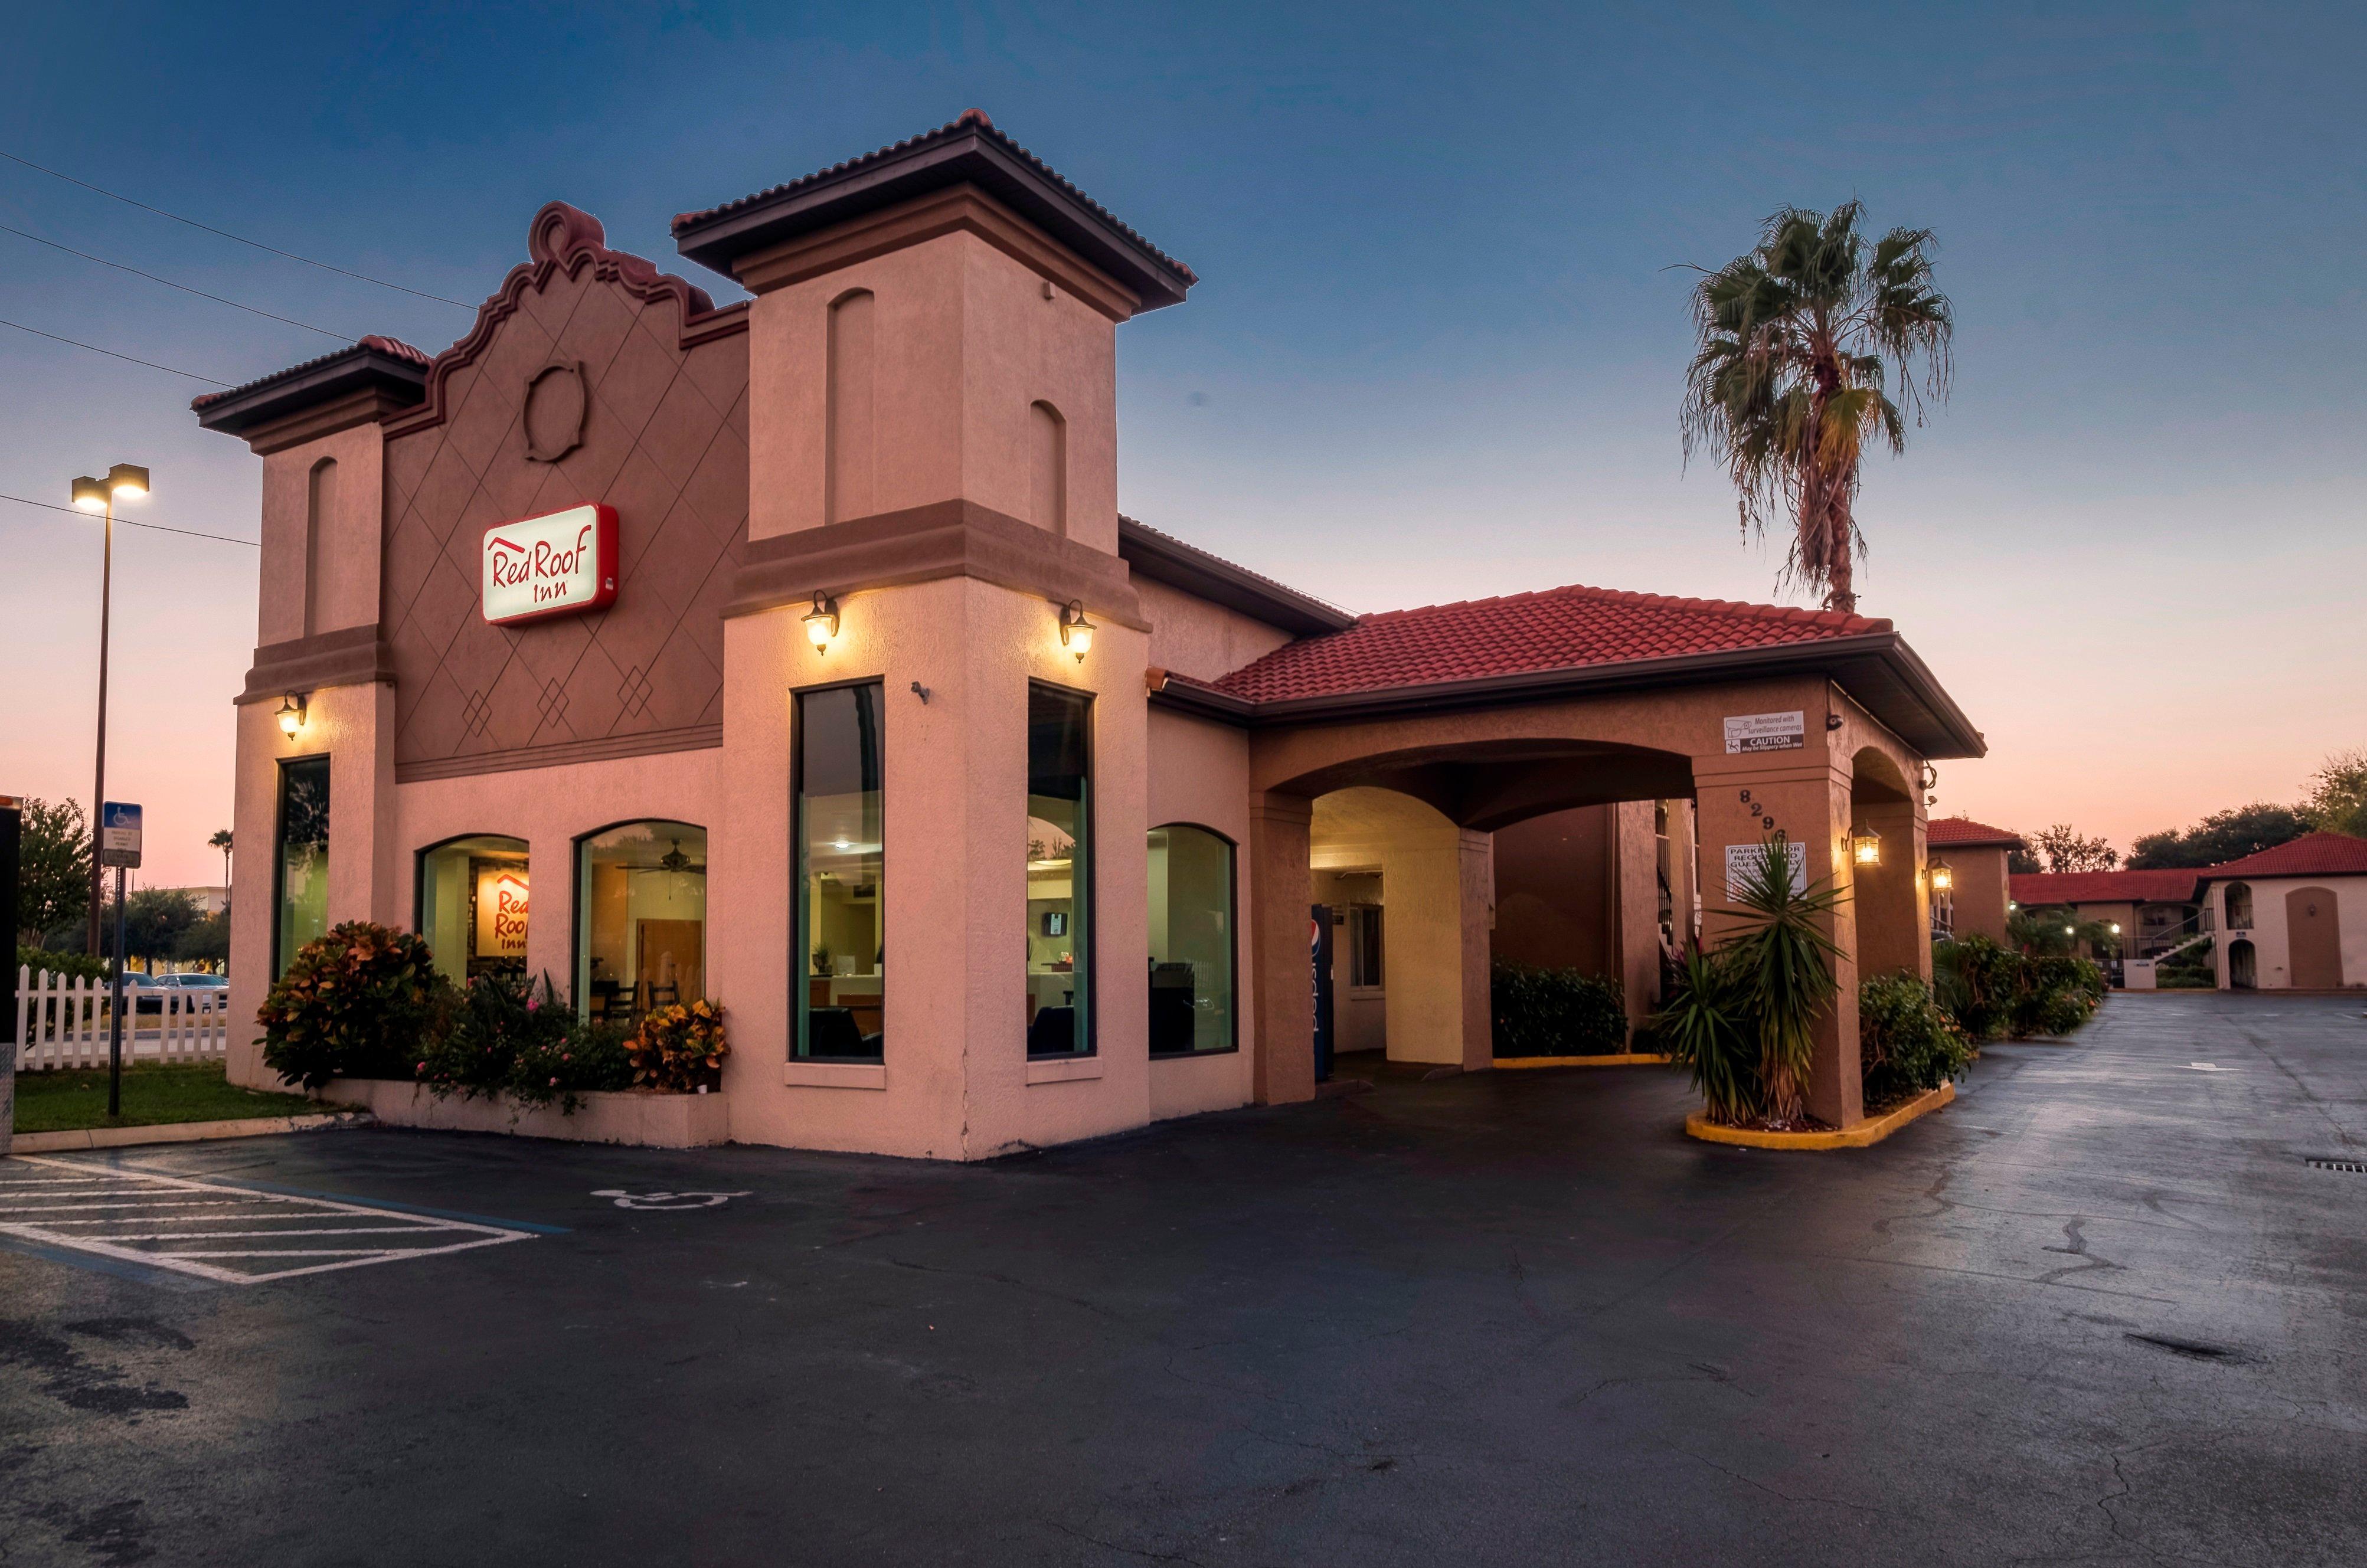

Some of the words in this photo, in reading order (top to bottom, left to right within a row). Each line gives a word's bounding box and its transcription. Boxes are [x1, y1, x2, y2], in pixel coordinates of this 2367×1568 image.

[493, 551, 532, 588] Red
[535, 525, 591, 578] Roof
[1754, 716, 1781, 724] Monitored
[1750, 736, 1790, 745] CAUTION
[495, 913, 528, 939] Roo
